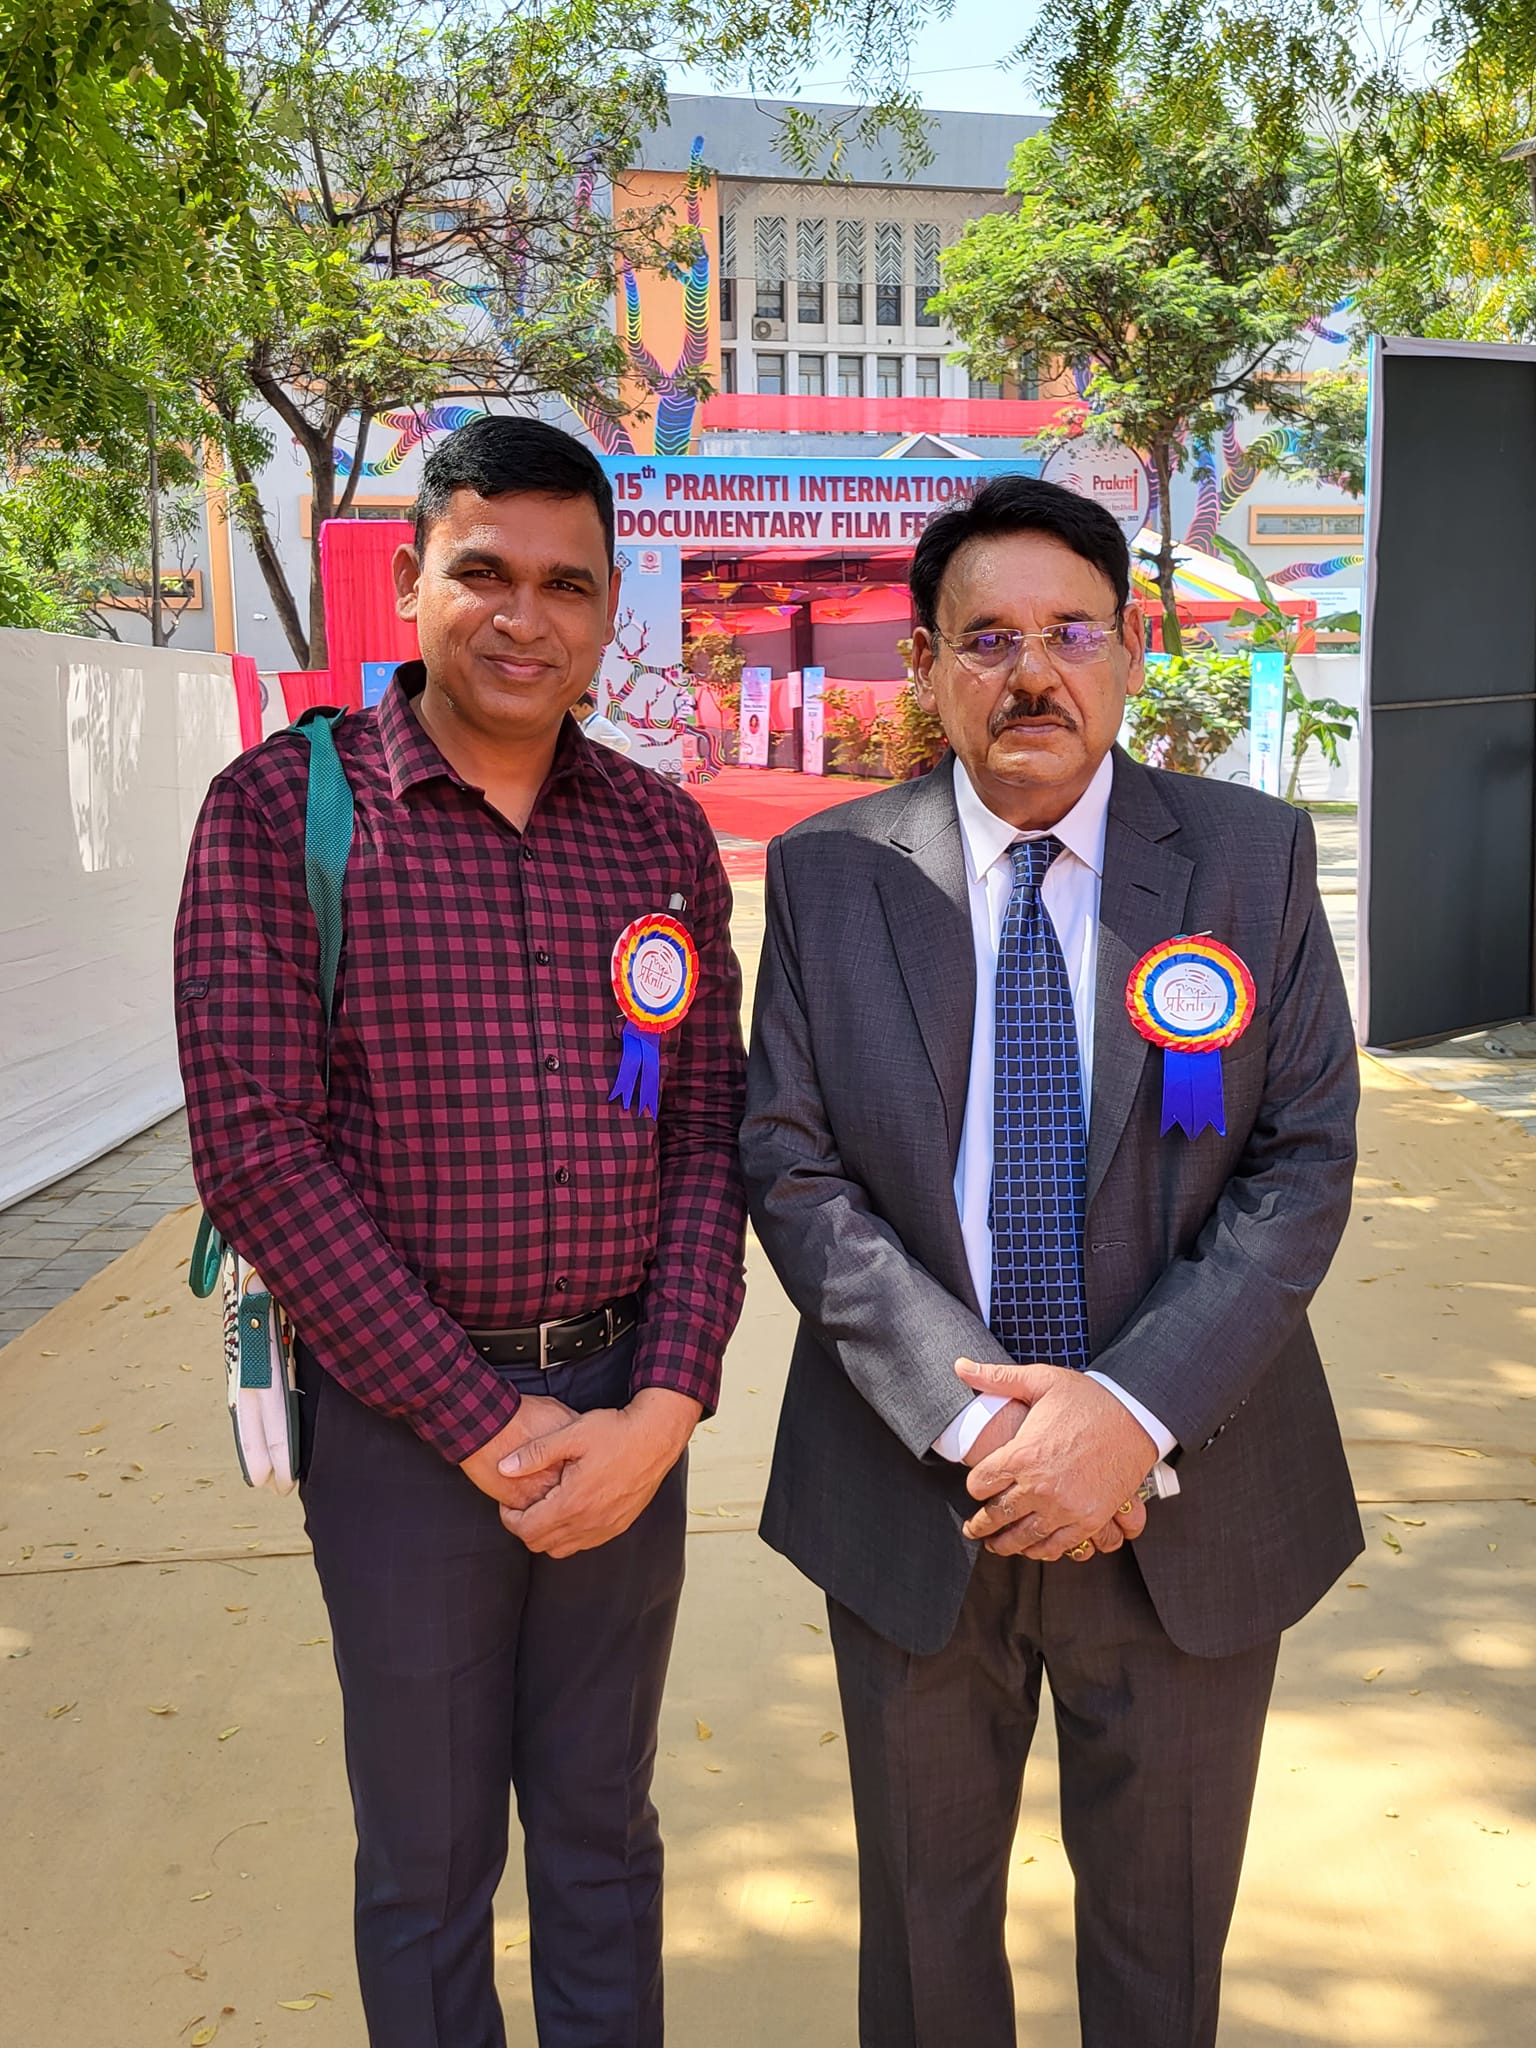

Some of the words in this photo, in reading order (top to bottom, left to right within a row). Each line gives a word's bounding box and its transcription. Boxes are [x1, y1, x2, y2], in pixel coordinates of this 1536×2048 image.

[615, 465, 656, 500] 15th
[665, 473, 789, 501] PRAKRITI
[1093, 468, 1138, 511] Prakriti
[617, 509, 823, 538] DOCUMENTARY
[831, 511, 891, 538] FILM
